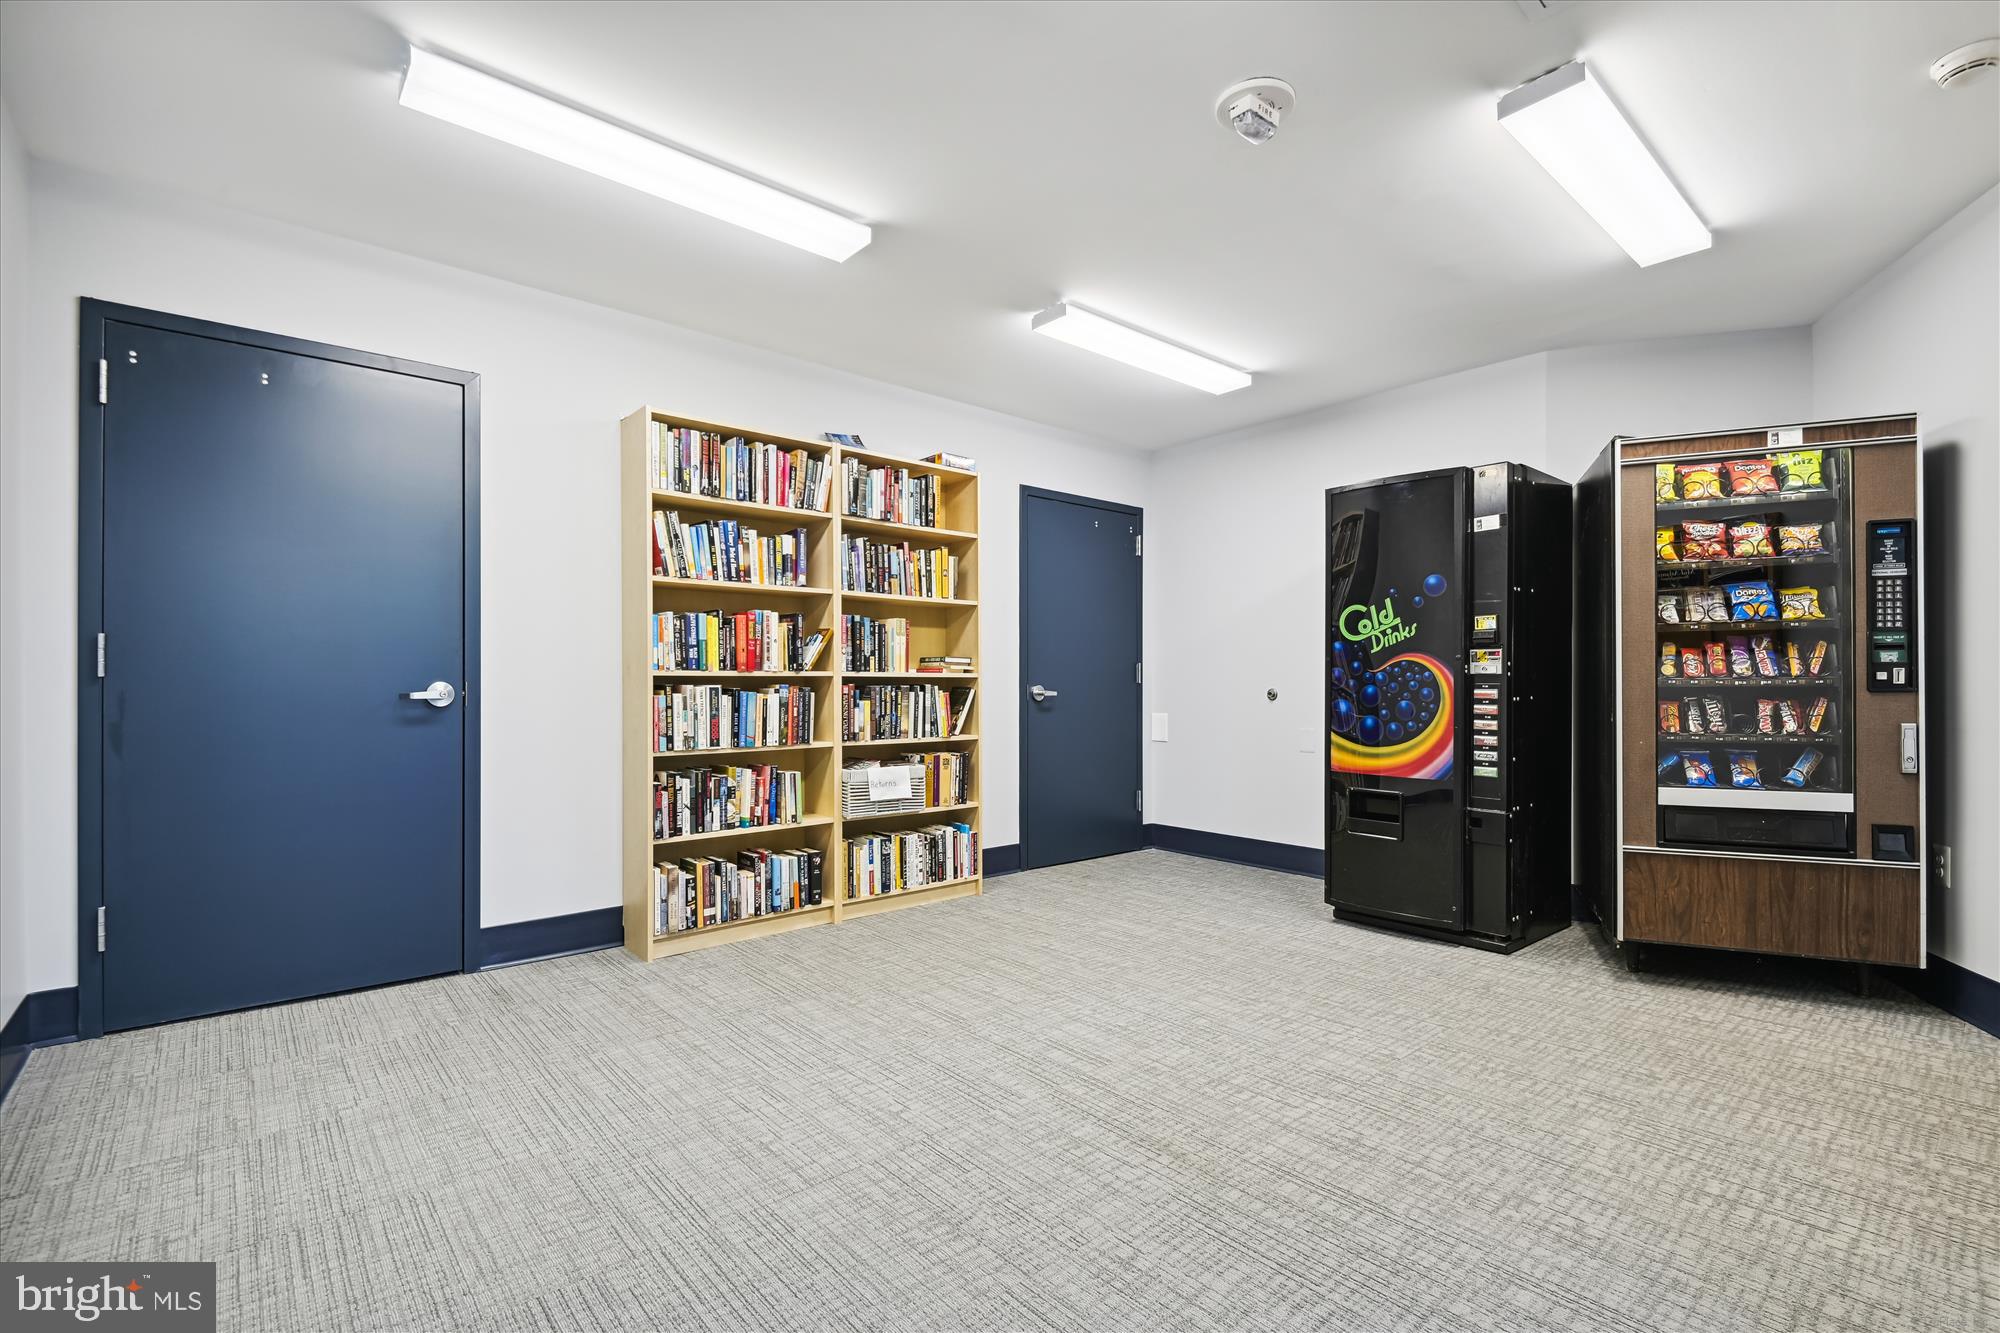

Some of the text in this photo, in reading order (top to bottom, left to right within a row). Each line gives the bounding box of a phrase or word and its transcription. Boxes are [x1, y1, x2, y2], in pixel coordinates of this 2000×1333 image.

[1258, 104, 1273, 118] FIRE
[1734, 464, 1766, 472] Doritos
[1735, 588, 1767, 597] Doritos
[1339, 597, 1401, 642] Cold
[1371, 622, 1417, 654] Drinks
[1754, 648, 1772, 677] CRUNCH
